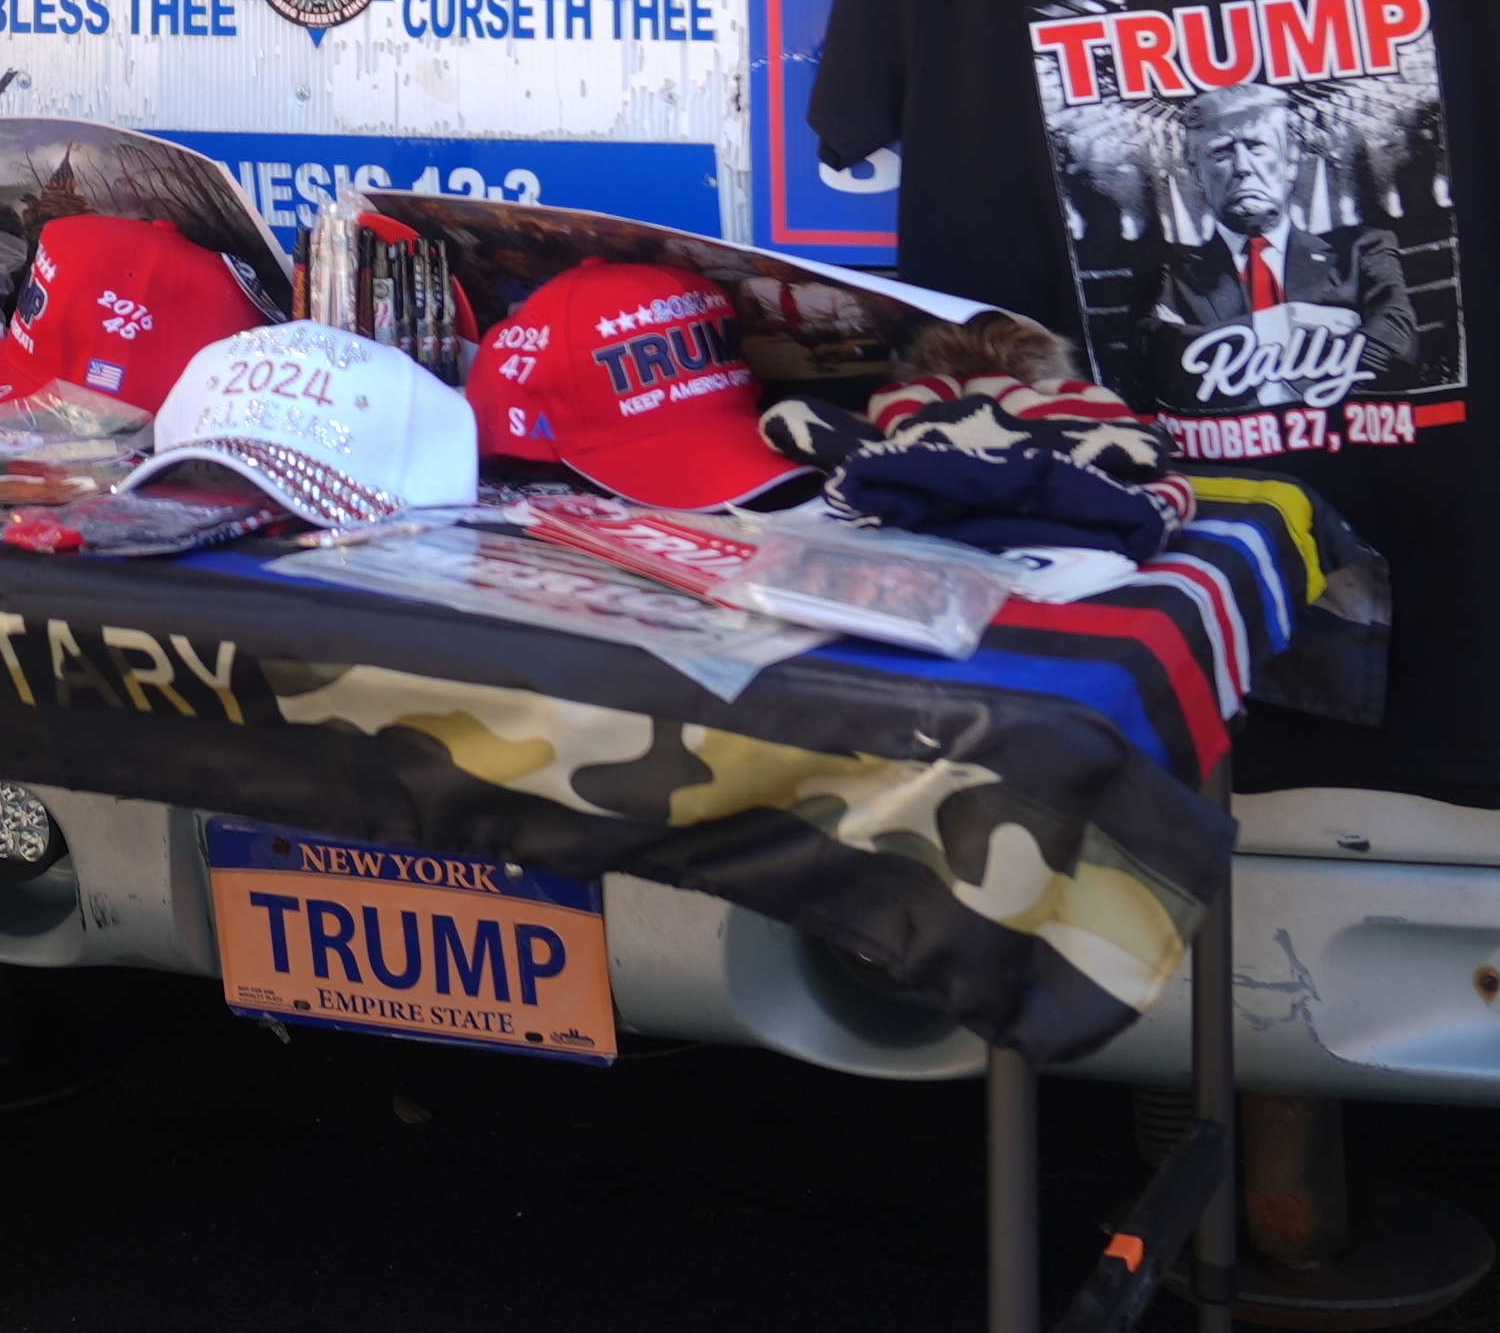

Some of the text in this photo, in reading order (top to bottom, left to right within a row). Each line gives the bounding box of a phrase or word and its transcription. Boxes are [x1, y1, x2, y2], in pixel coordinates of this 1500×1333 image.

[219, 161, 392, 226] NESIS
[97, 290, 154, 331] 2016
[103, 317, 142, 341] 45
[493, 325, 550, 351] 2024
[591, 316, 742, 395] TRUM
[222, 360, 334, 406] 2024
[500, 354, 537, 384] 47
[1181, 324, 1376, 408] Rally
[619, 389, 666, 417] KEEP
[670, 372, 728, 402] AMERICA
[1286, 409, 1342, 453] 27,
[1345, 403, 1416, 443] 2024
[299, 843, 501, 893] NEW YORK
[250, 891, 566, 1006] TRUMP
[317, 987, 515, 1035] EMPIRE STATE
